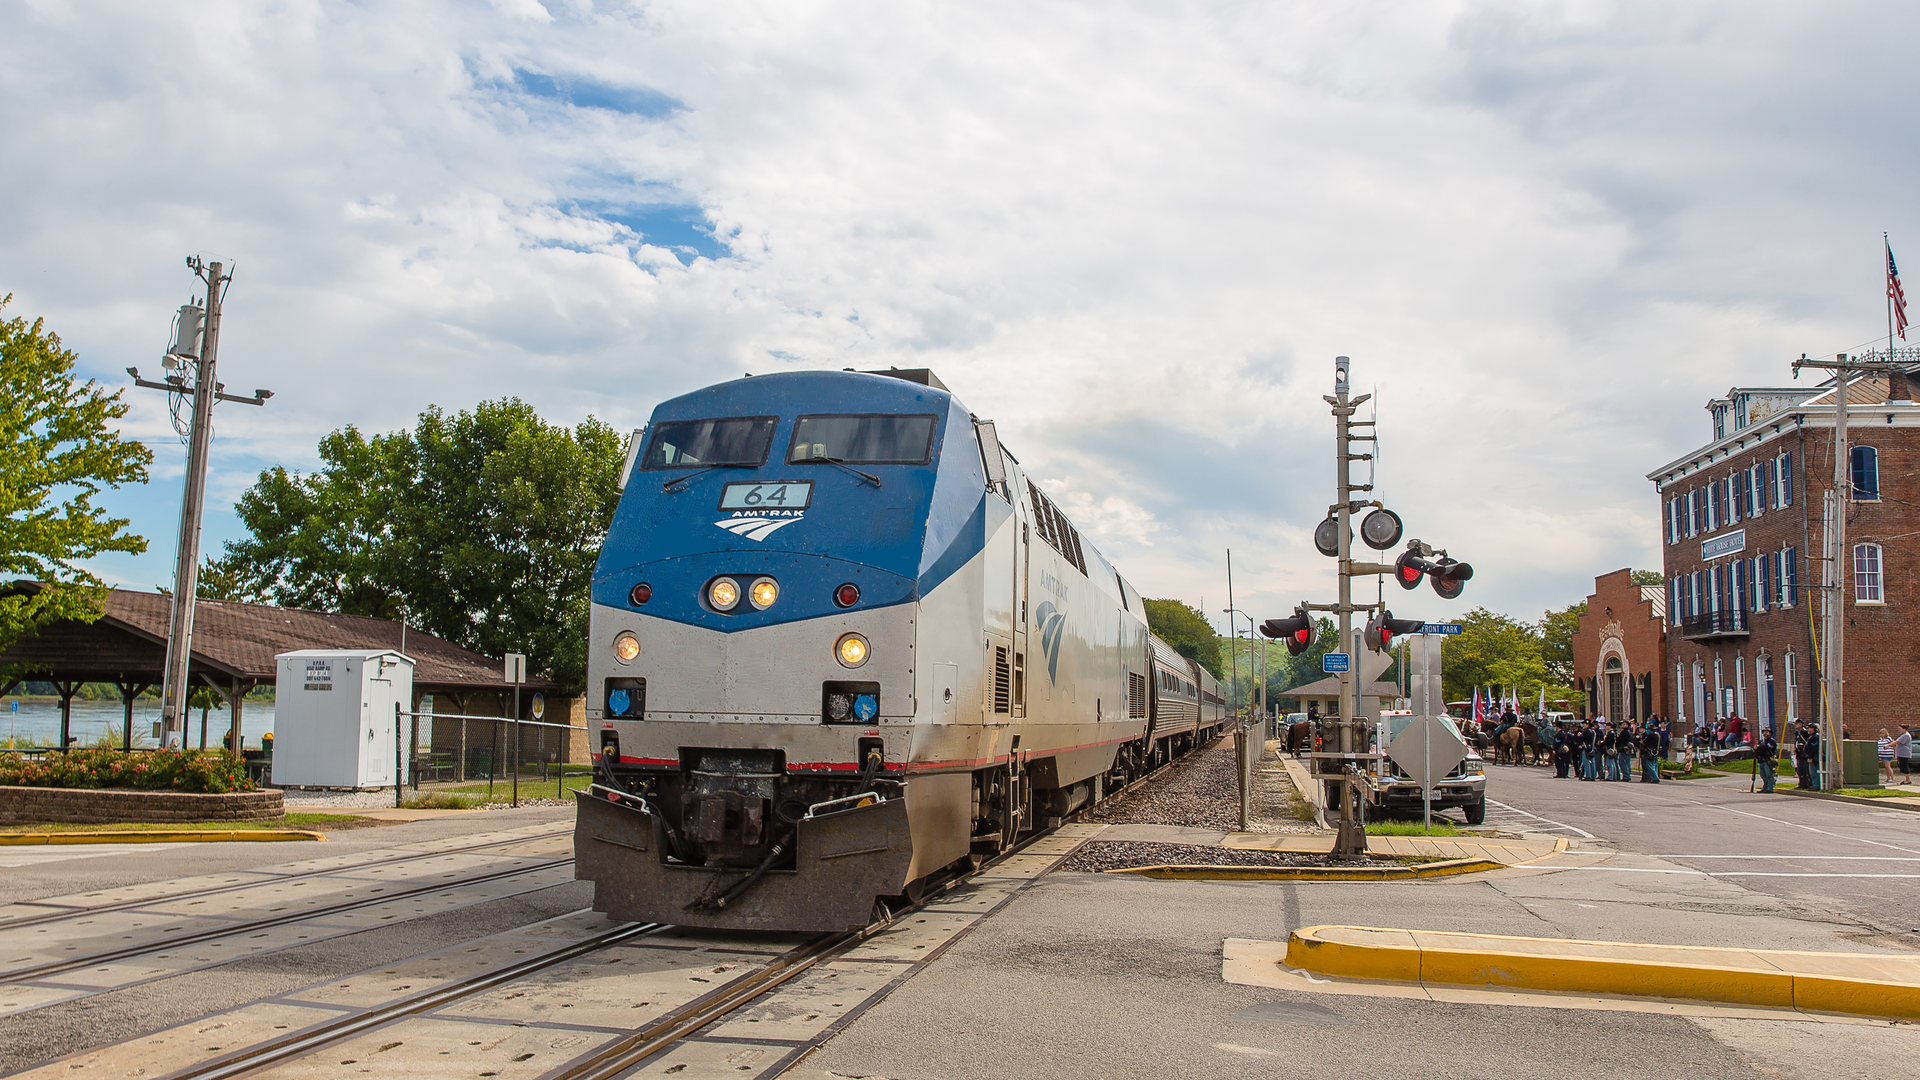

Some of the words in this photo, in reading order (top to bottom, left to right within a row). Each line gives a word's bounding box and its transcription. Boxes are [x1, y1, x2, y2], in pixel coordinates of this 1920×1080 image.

[744, 485, 787, 505] 64
[1716, 540, 1729, 551] HOUSE
[1730, 536, 1743, 548] HOTEL
[1040, 569, 1068, 603] AMTRAK
[1442, 625, 1459, 633] PARK
